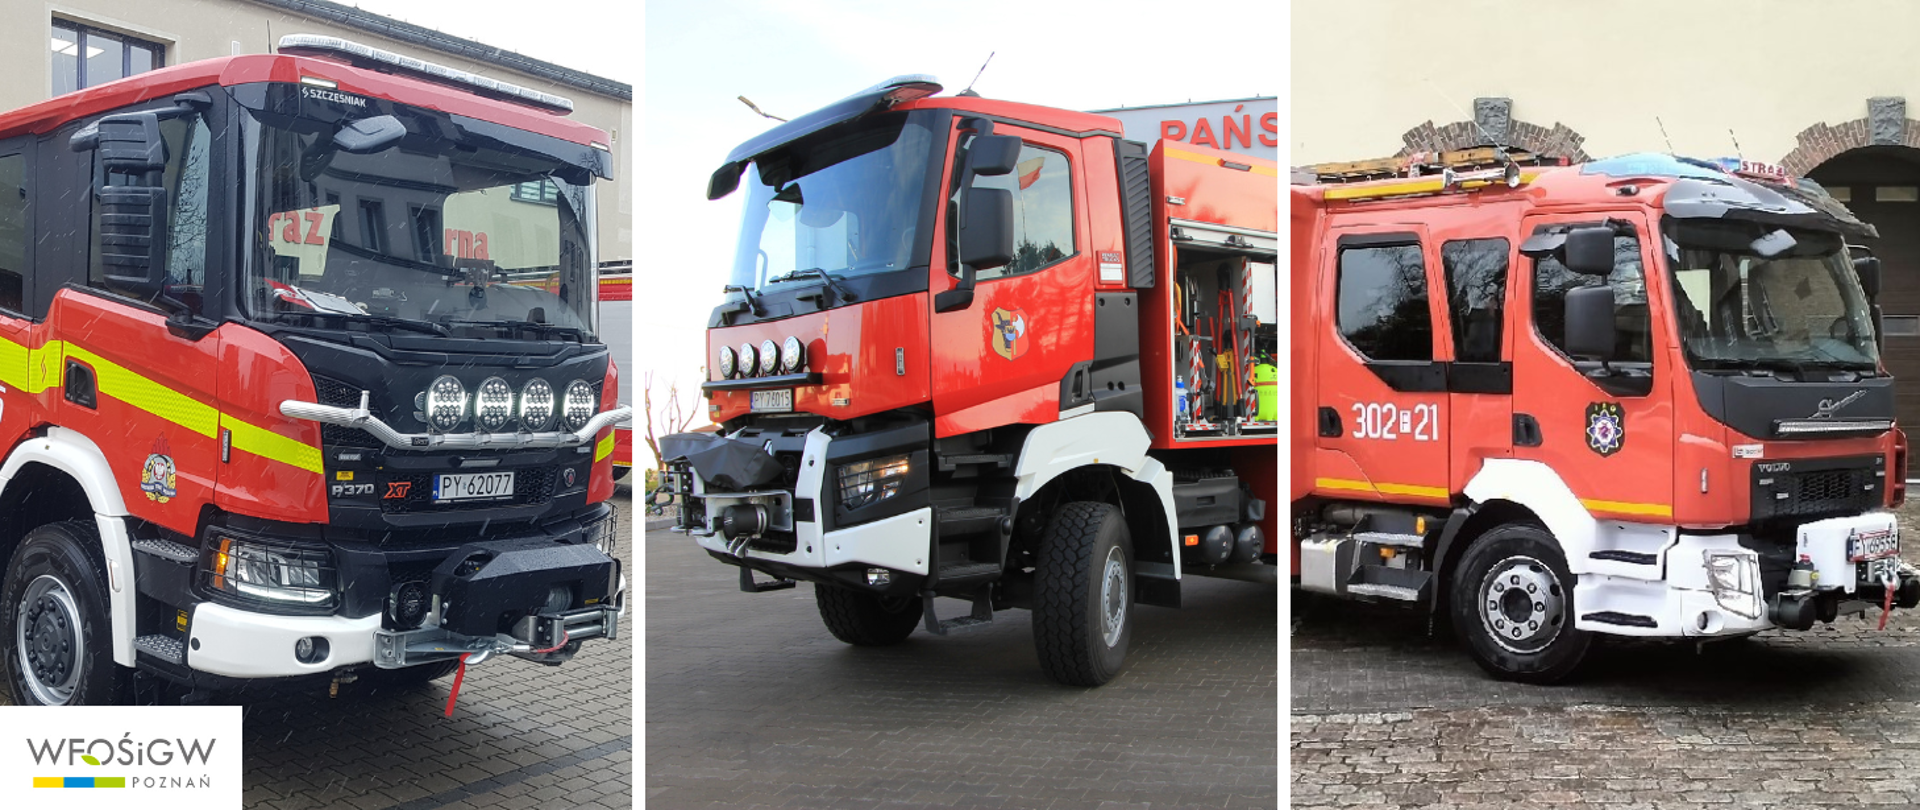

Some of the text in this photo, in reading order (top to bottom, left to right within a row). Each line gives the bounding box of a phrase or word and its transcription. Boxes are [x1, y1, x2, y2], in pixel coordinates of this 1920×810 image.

[753, 392, 764, 407] PY
[1351, 402, 1397, 439] 302
[1414, 403, 1439, 441] 21
[1757, 463, 1791, 473] VOLVO
[383, 481, 412, 499] XT
[442, 474, 511, 497] PY 62077
